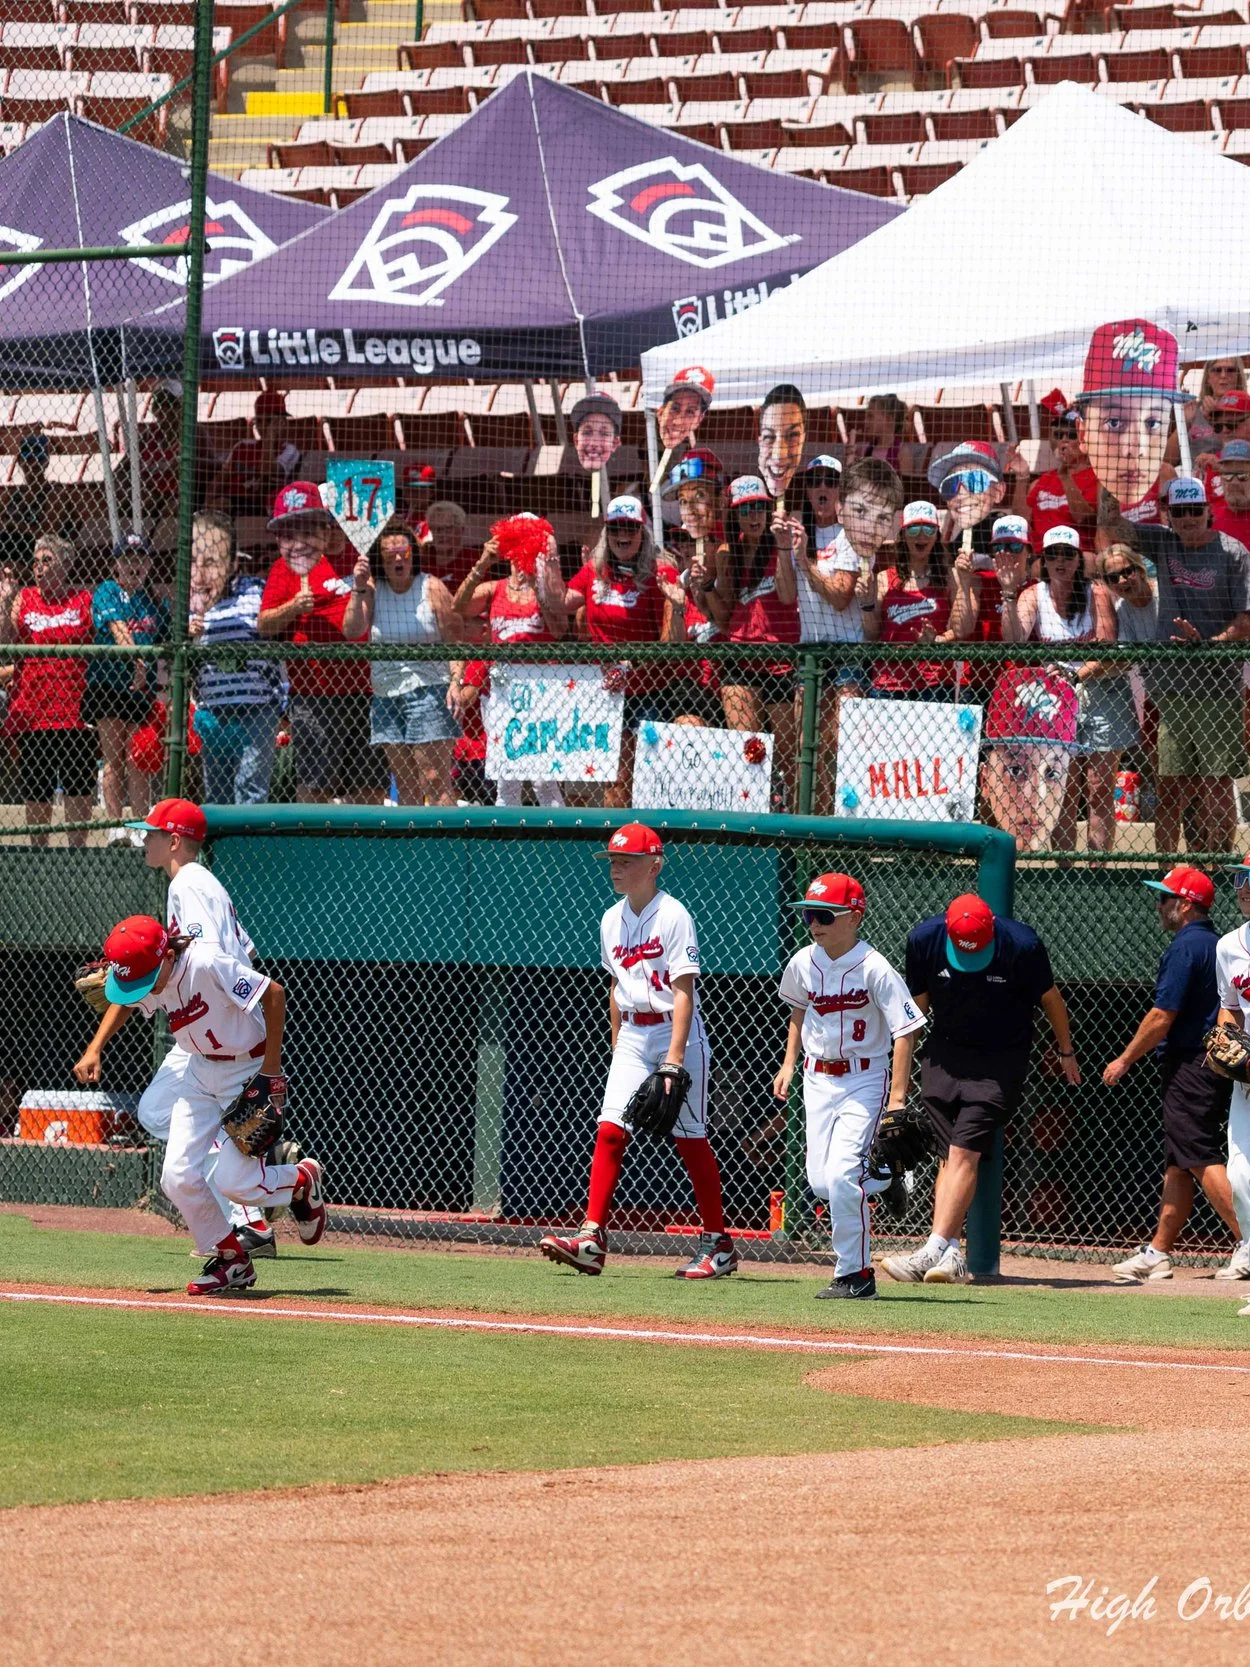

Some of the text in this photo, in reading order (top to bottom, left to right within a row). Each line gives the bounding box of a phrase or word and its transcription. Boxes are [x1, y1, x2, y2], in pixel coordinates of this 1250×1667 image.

[250, 328, 481, 374] Little League
[344, 477, 382, 521] 17
[1175, 488, 1199, 499] MH
[504, 706, 611, 761] Camden
[205, 1029, 222, 1050] 1
[852, 1020, 867, 1041] 8
